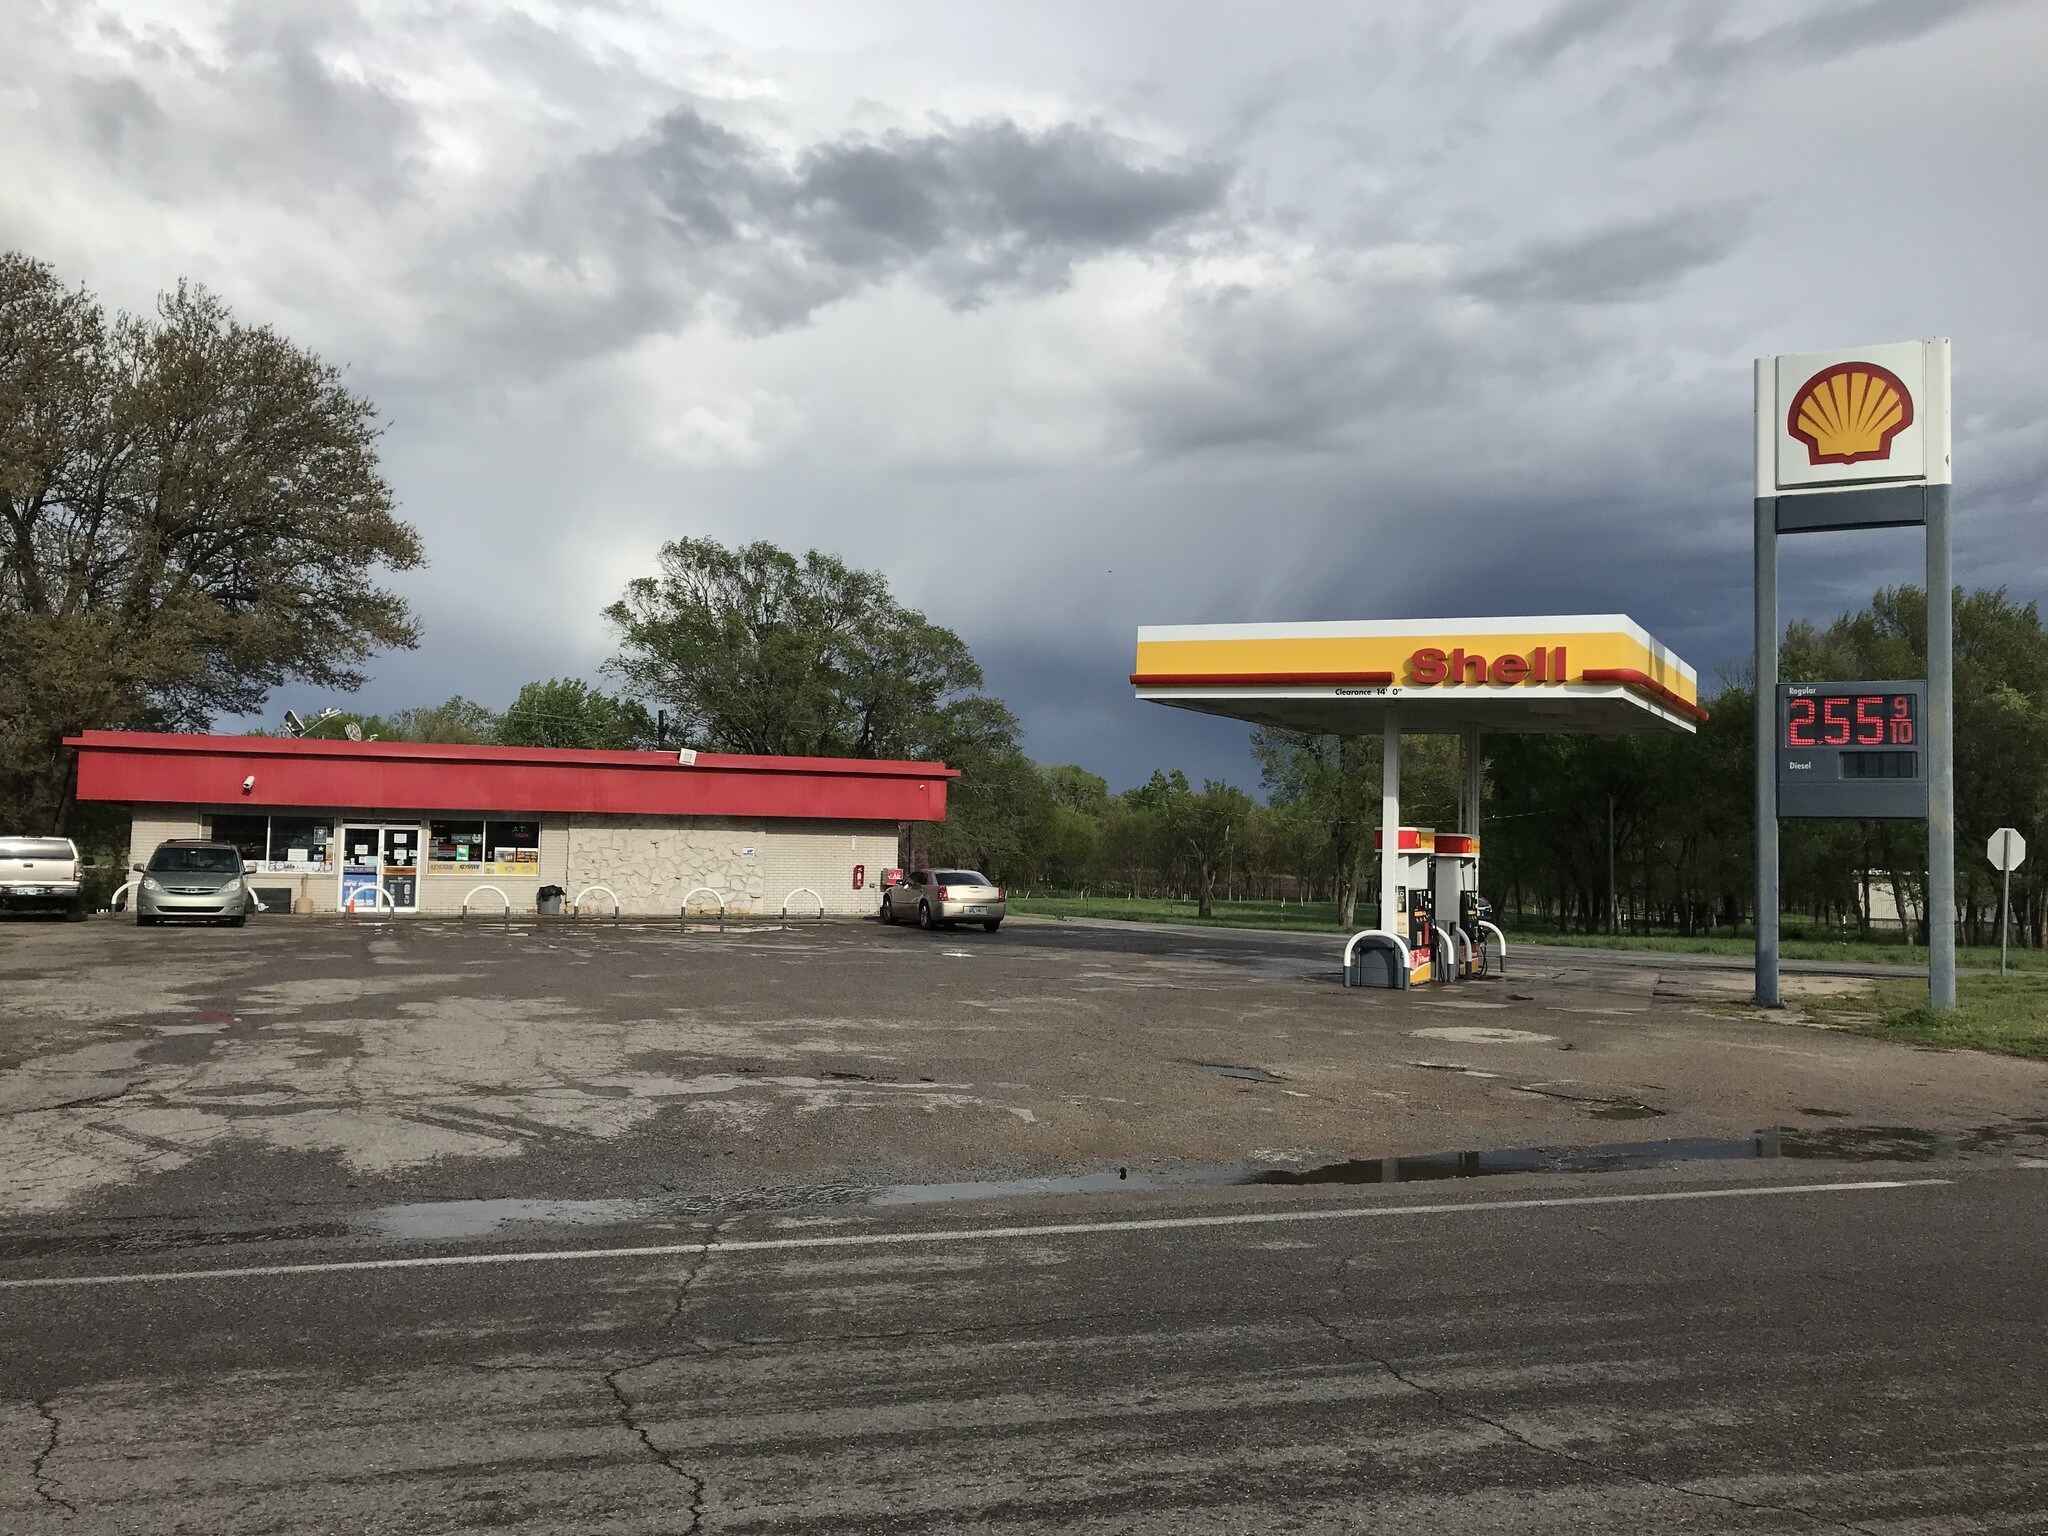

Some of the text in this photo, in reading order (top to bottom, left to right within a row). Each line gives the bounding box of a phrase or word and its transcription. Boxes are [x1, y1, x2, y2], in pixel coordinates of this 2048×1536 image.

[1410, 647, 1567, 684] Shell
[1335, 687, 1372, 696] Clearance
[1377, 687, 1388, 696] 14'
[1789, 687, 1817, 696] Regular
[1893, 696, 1908, 718] 9
[1889, 721, 1913, 744] 10
[1789, 761, 1812, 770] Diesel
